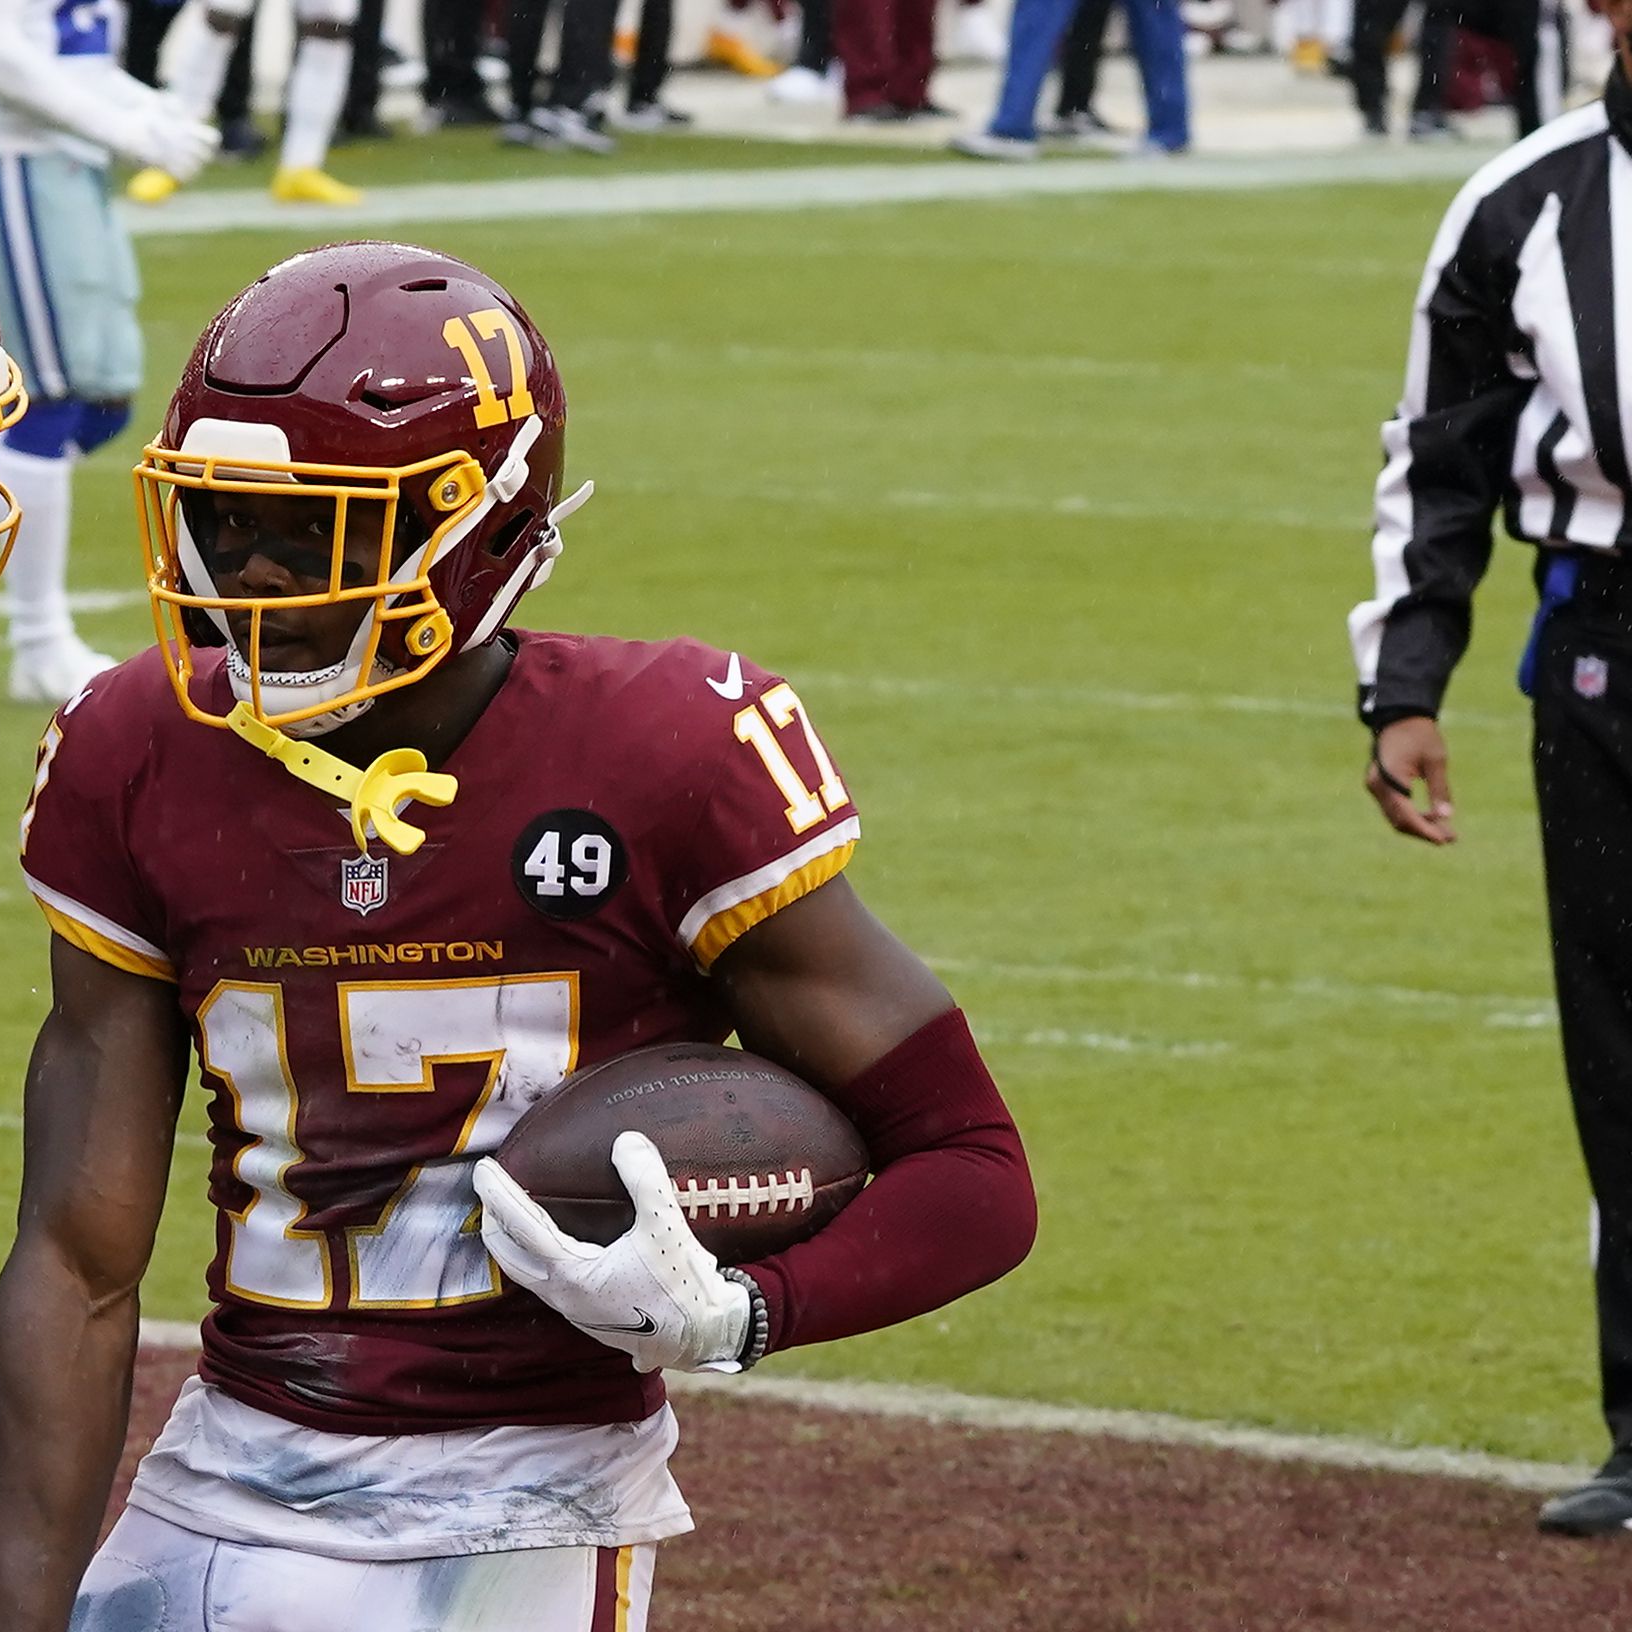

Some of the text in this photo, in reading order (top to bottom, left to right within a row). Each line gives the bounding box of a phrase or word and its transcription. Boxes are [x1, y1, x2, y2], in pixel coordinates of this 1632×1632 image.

[441, 307, 537, 430] 17
[733, 682, 850, 835] 17
[349, 880, 380, 904] NFL
[524, 830, 612, 896] 49
[242, 940, 503, 969] WASHINGTON
[197, 970, 581, 1309] 17
